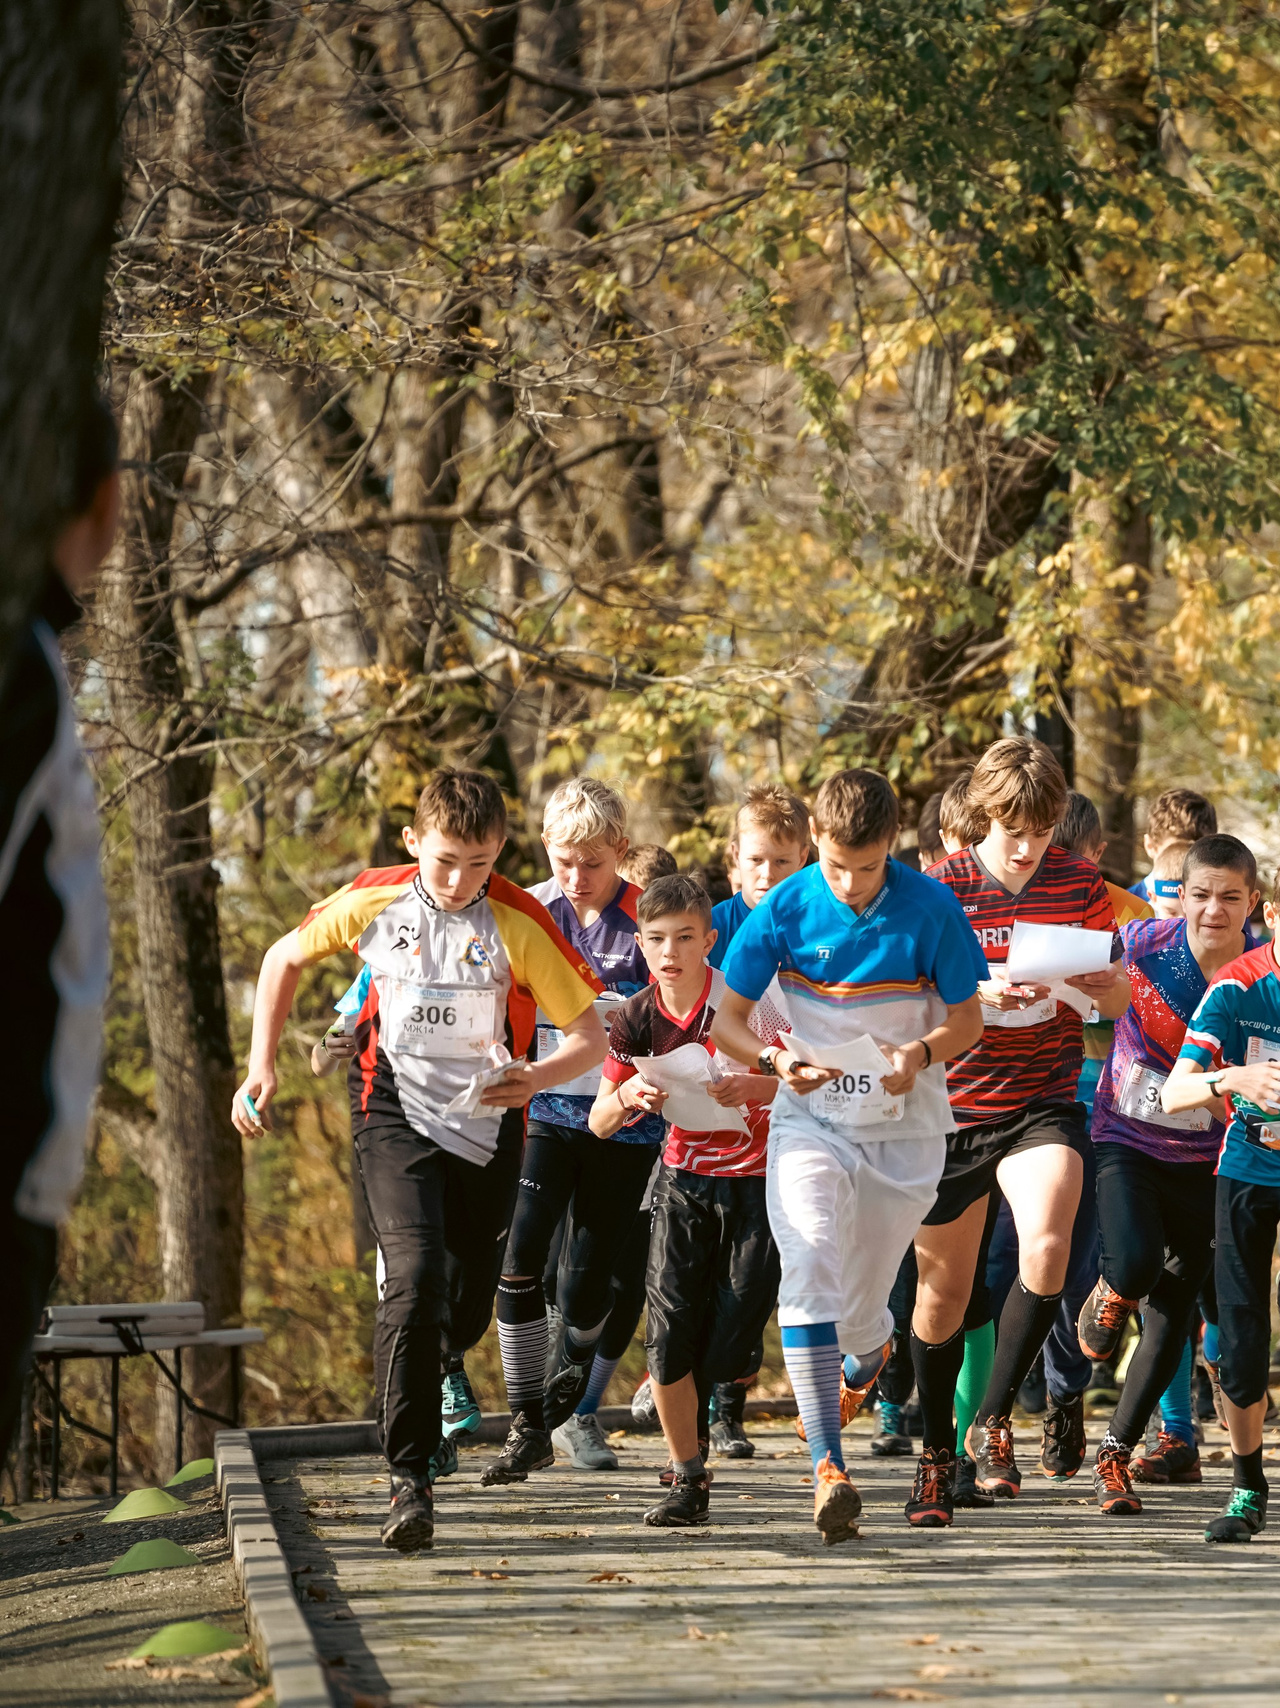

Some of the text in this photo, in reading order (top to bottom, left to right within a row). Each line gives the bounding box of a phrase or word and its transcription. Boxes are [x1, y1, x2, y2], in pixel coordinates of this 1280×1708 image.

[410, 1005, 473, 1029] 306 1
[403, 1023, 434, 1035] МЖ14
[828, 1074, 871, 1094] 305
[1137, 1098, 1163, 1113] МЖ14
